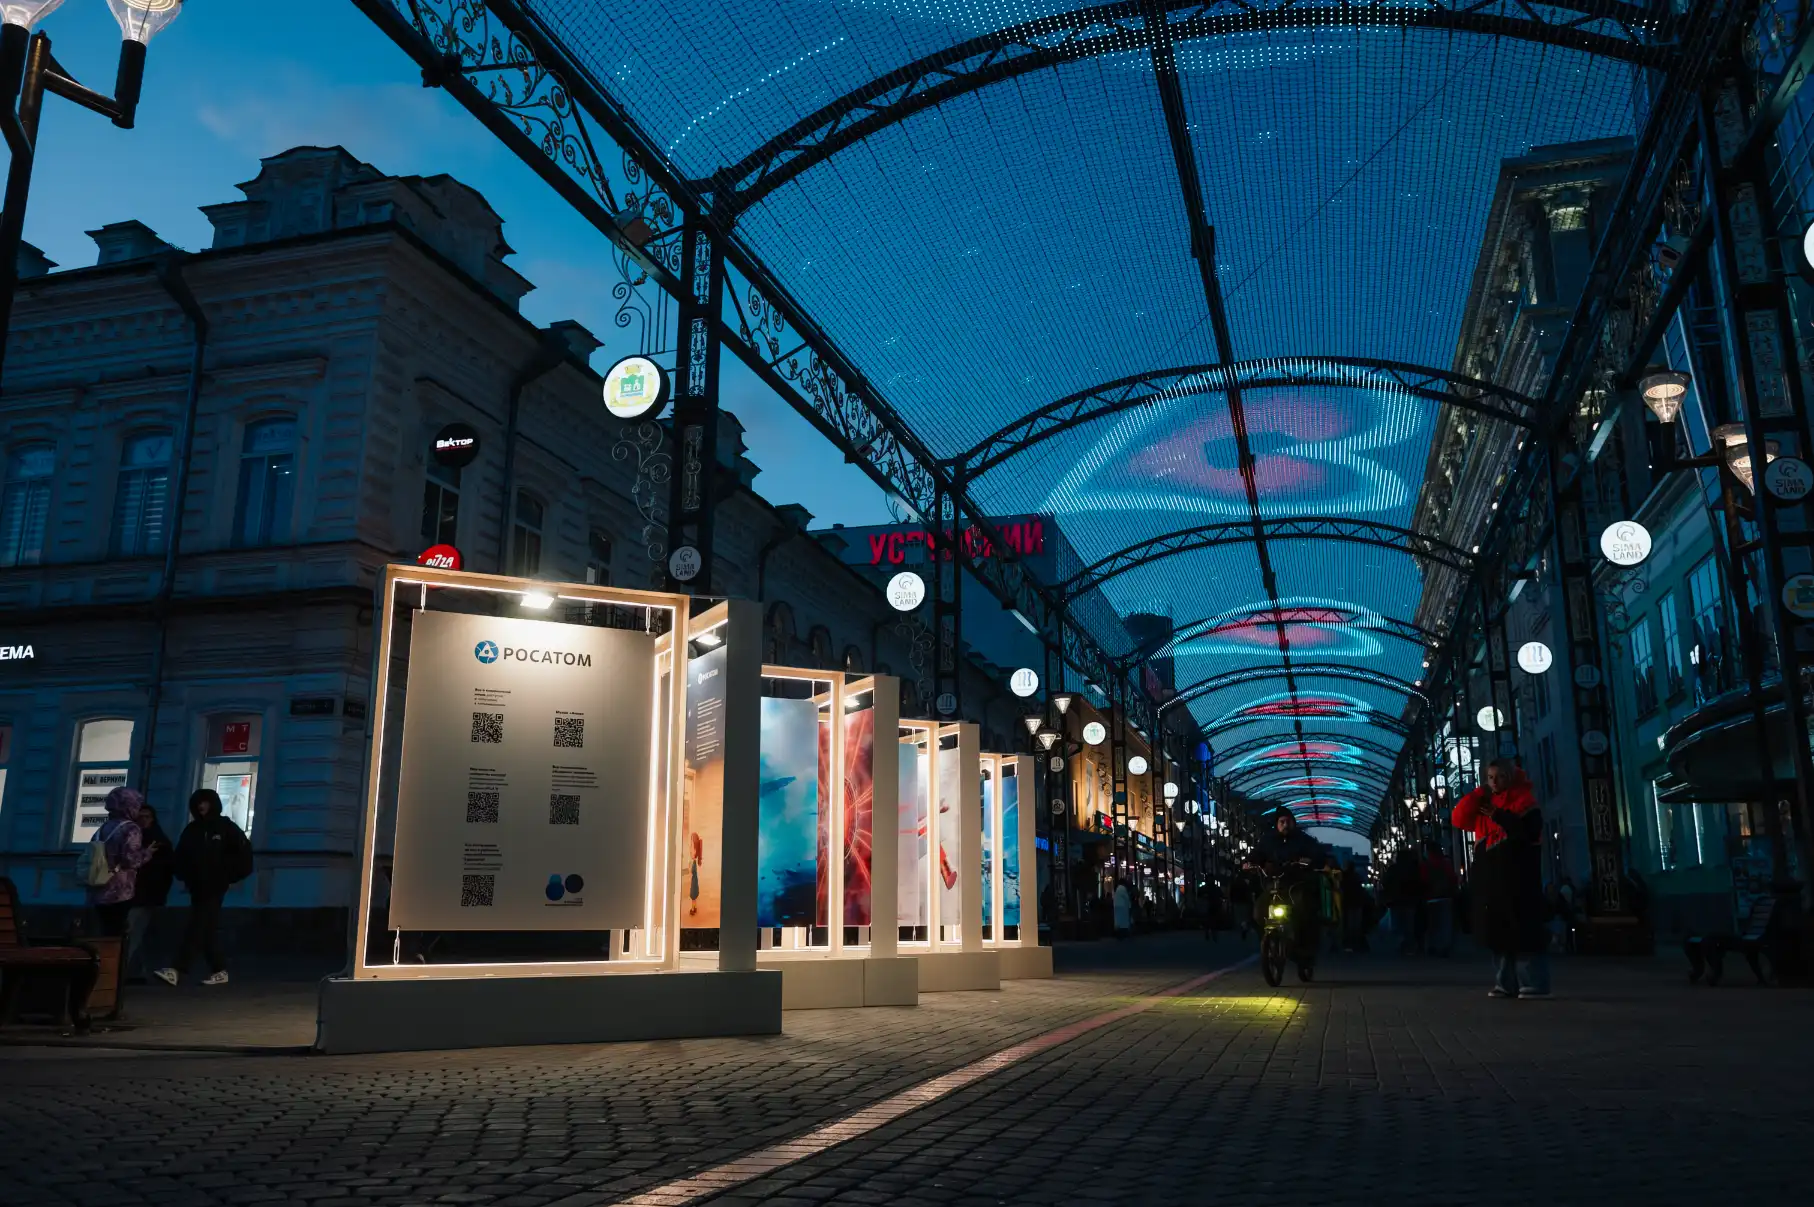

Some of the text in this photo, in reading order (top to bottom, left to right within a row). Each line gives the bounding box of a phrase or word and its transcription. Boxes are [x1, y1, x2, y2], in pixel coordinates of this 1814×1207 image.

[1612, 543, 1642, 552] SIMA
[1613, 551, 1643, 560] LAND
[676, 563, 695, 571] SIMA
[894, 591, 917, 600] SIMA
[895, 599, 918, 607] LAND
[503, 647, 592, 668] РОСАТОМ
